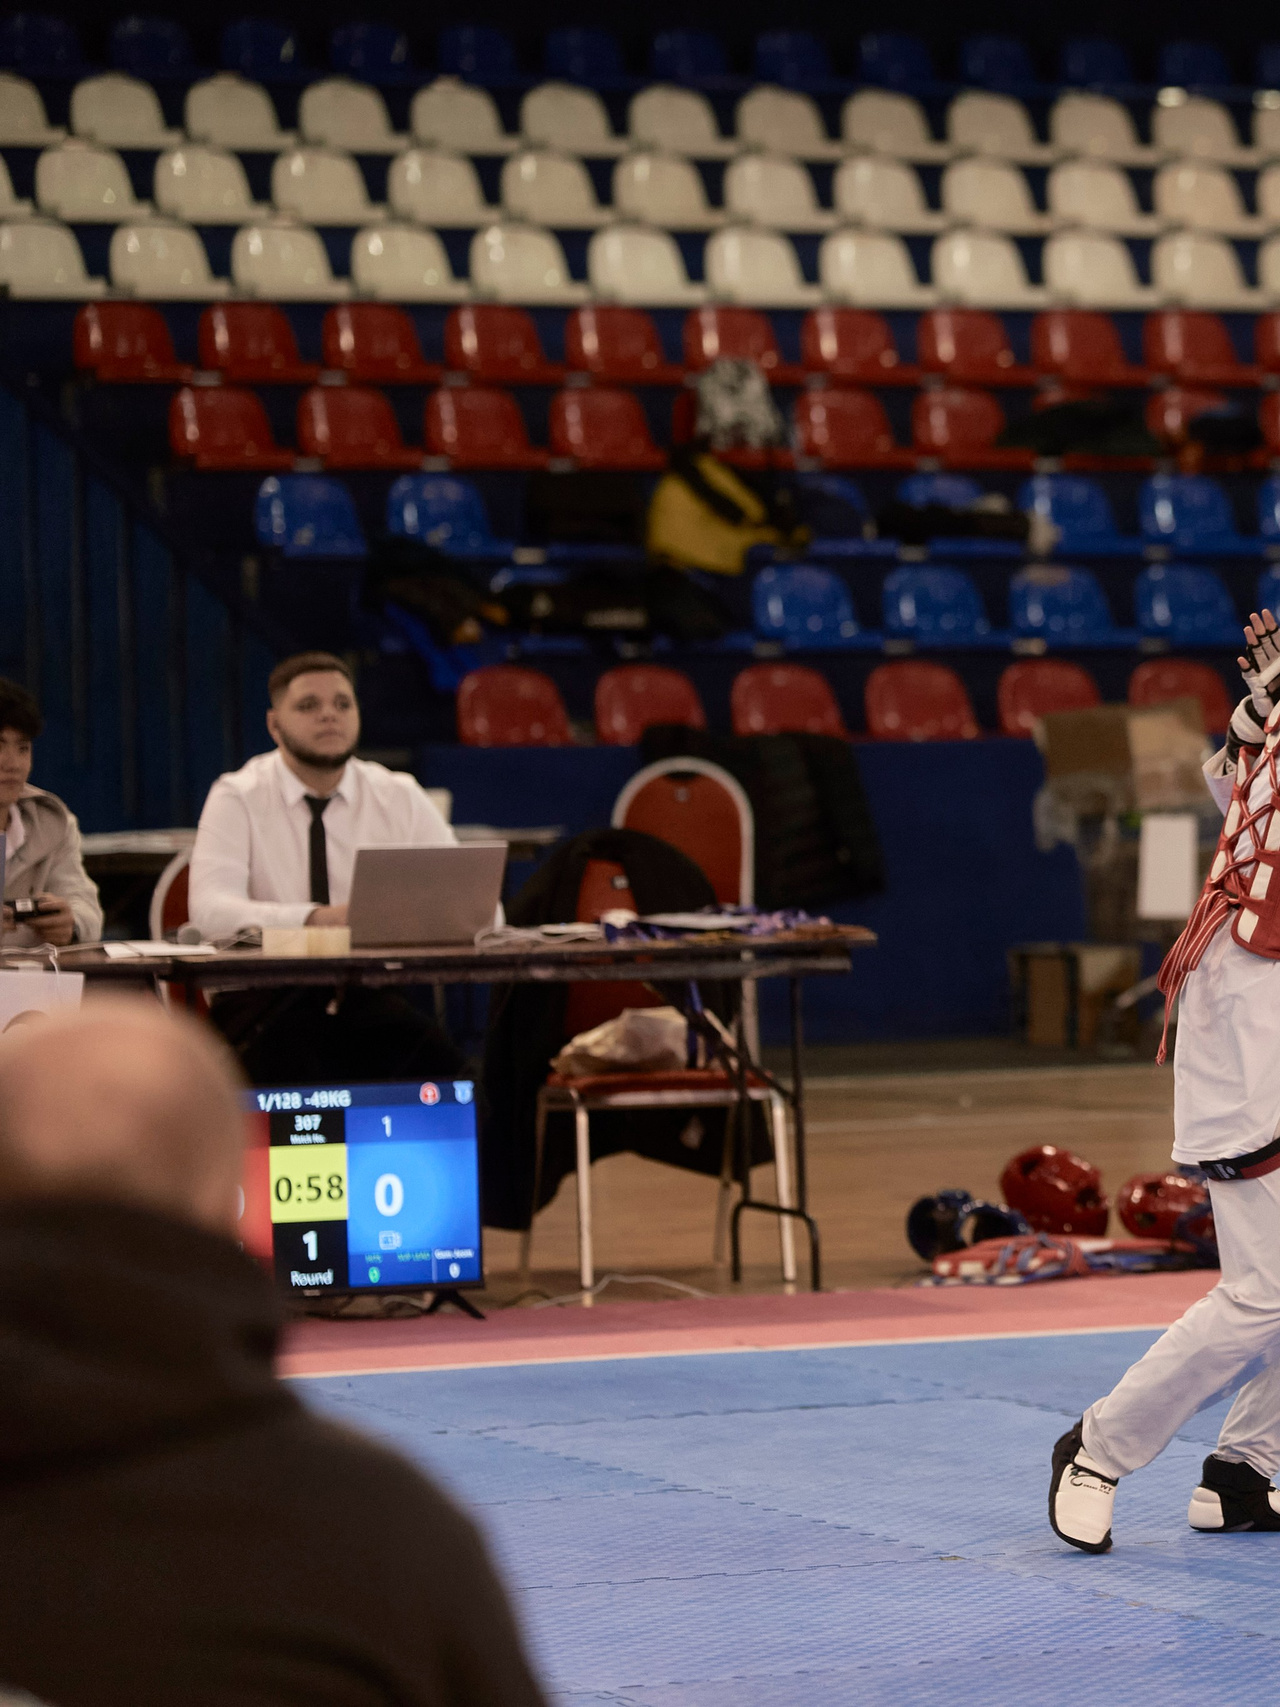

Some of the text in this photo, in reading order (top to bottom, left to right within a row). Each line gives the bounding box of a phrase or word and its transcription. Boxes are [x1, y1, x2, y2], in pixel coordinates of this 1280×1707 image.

[294, 1114, 322, 1131] 307
[381, 1115, 392, 1137] 1
[275, 1175, 344, 1203] 0:58
[374, 1173, 404, 1217] 0
[302, 1230, 318, 1261] 1
[290, 1269, 334, 1287] Round
